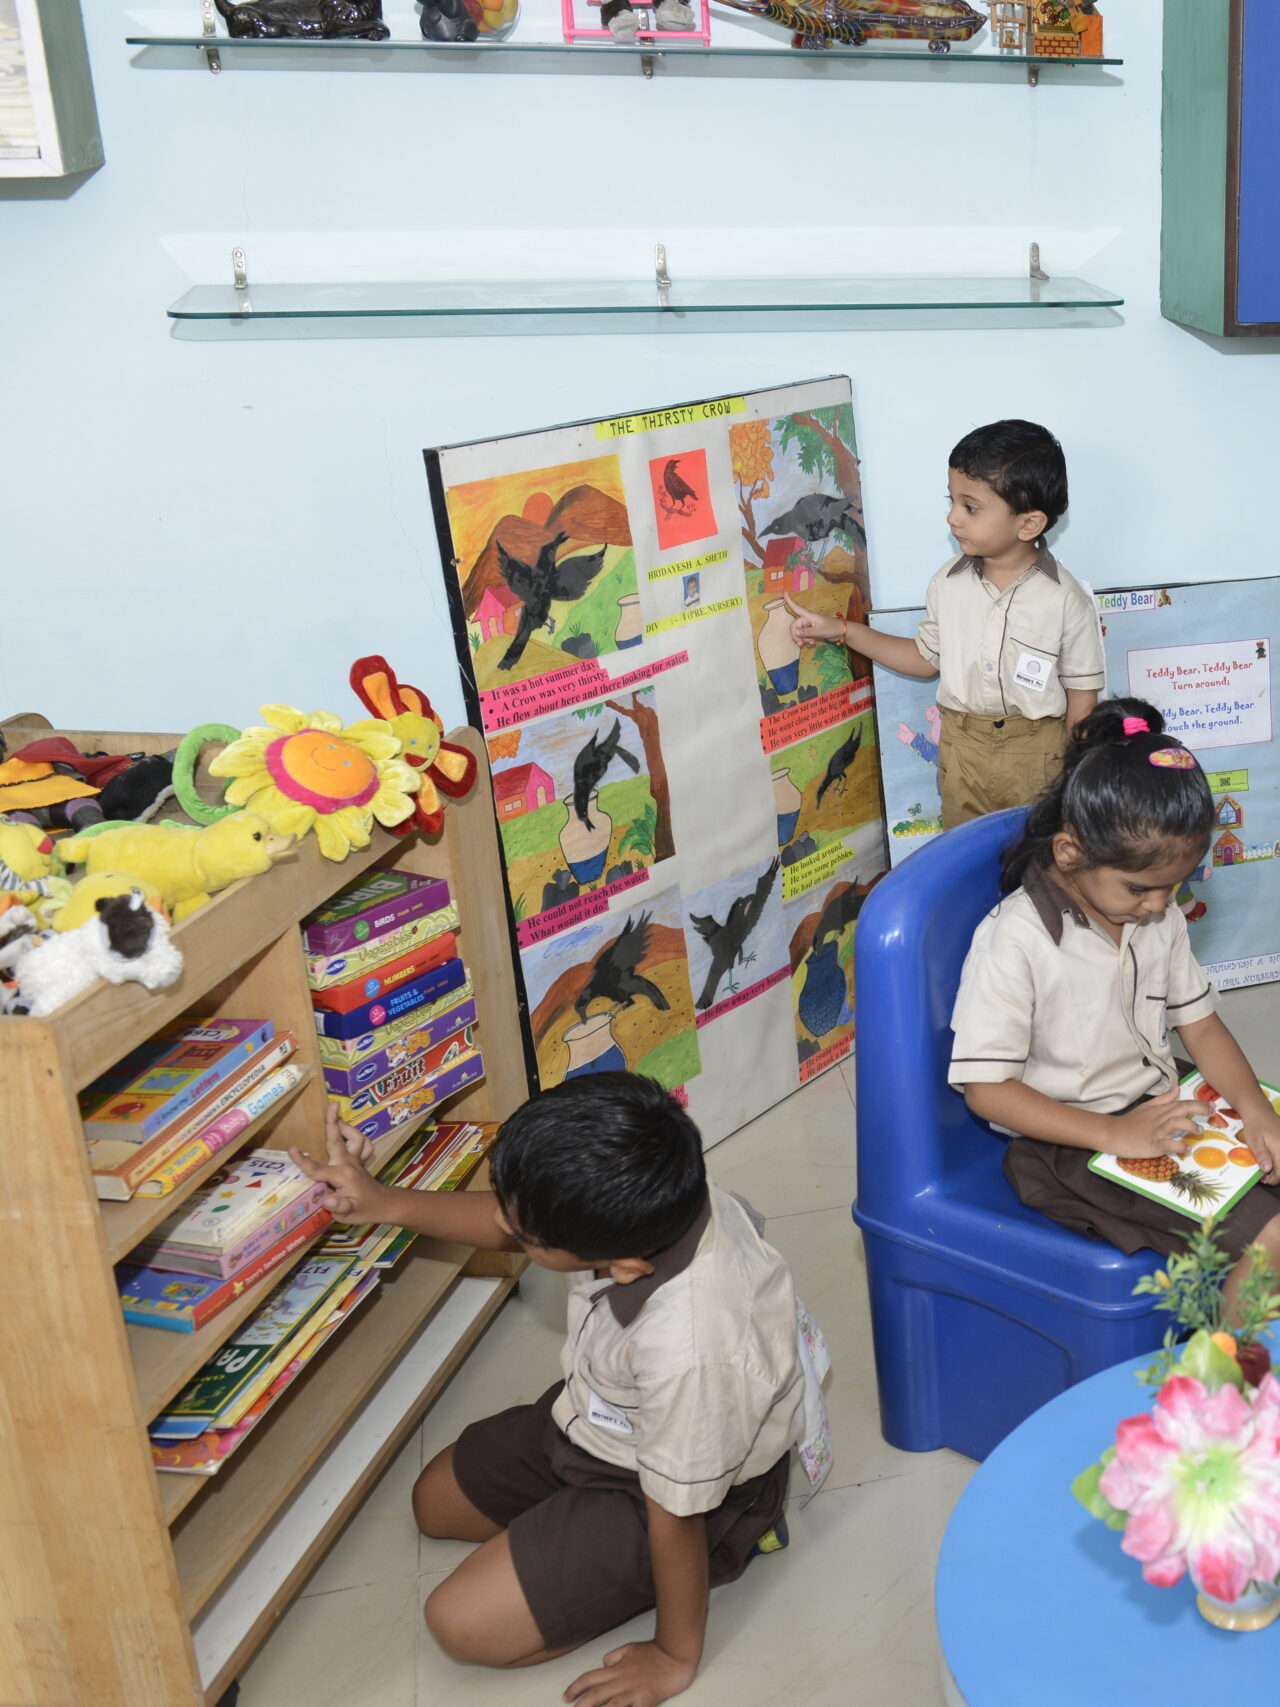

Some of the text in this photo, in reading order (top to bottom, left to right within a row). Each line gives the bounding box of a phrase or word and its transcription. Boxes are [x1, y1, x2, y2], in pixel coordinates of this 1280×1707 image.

[610, 401, 731, 436] THE THIRSTY CROW
[1098, 592, 1154, 610] Teddy Bear
[646, 622, 658, 633] DIV
[492, 691, 500, 700] It
[502, 687, 520, 697] was
[528, 678, 544, 689] hot
[545, 666, 579, 684] summer
[581, 660, 599, 673] day.
[1146, 666, 1174, 679] Teddy
[1203, 662, 1230, 673] Teddy
[1232, 661, 1253, 670] Bear
[497, 653, 689, 728] He flew about here and there looking for water.
[502, 671, 609, 712] A Crow was very thirsty.
[1171, 681, 1194, 690] Turn
[768, 715, 781, 726] The
[782, 708, 799, 720] Crow
[1205, 702, 1232, 714] Teddy
[1234, 701, 1255, 710] Bear
[768, 727, 778, 738] He
[779, 721, 794, 733] went
[1163, 715, 1242, 732] ouch the ground.
[770, 738, 780, 749] He
[781, 734, 792, 744] saw
[790, 841, 844, 874] He looked around.
[790, 849, 854, 885] He saw some pebbles.
[527, 871, 649, 929] He could not reach the water.
[790, 887, 799, 896] He
[374, 913, 396, 928] BIRDS
[530, 900, 608, 942] What would it do?
[384, 965, 416, 986] NUMBERS
[387, 994, 425, 1016] VEGETABLES
[390, 991, 412, 1006] FRUITS
[704, 1008, 714, 1021] He
[731, 992, 751, 1007] away
[751, 983, 765, 998] very
[805, 1057, 815, 1069] He
[815, 1046, 832, 1062] could
[832, 1034, 849, 1051] reach
[189, 1071, 220, 1099] Letters
[220, 1063, 267, 1108] ENCYCLOPEDIA
[379, 1056, 425, 1097] Fruit
[248, 1083, 285, 1115] Games
